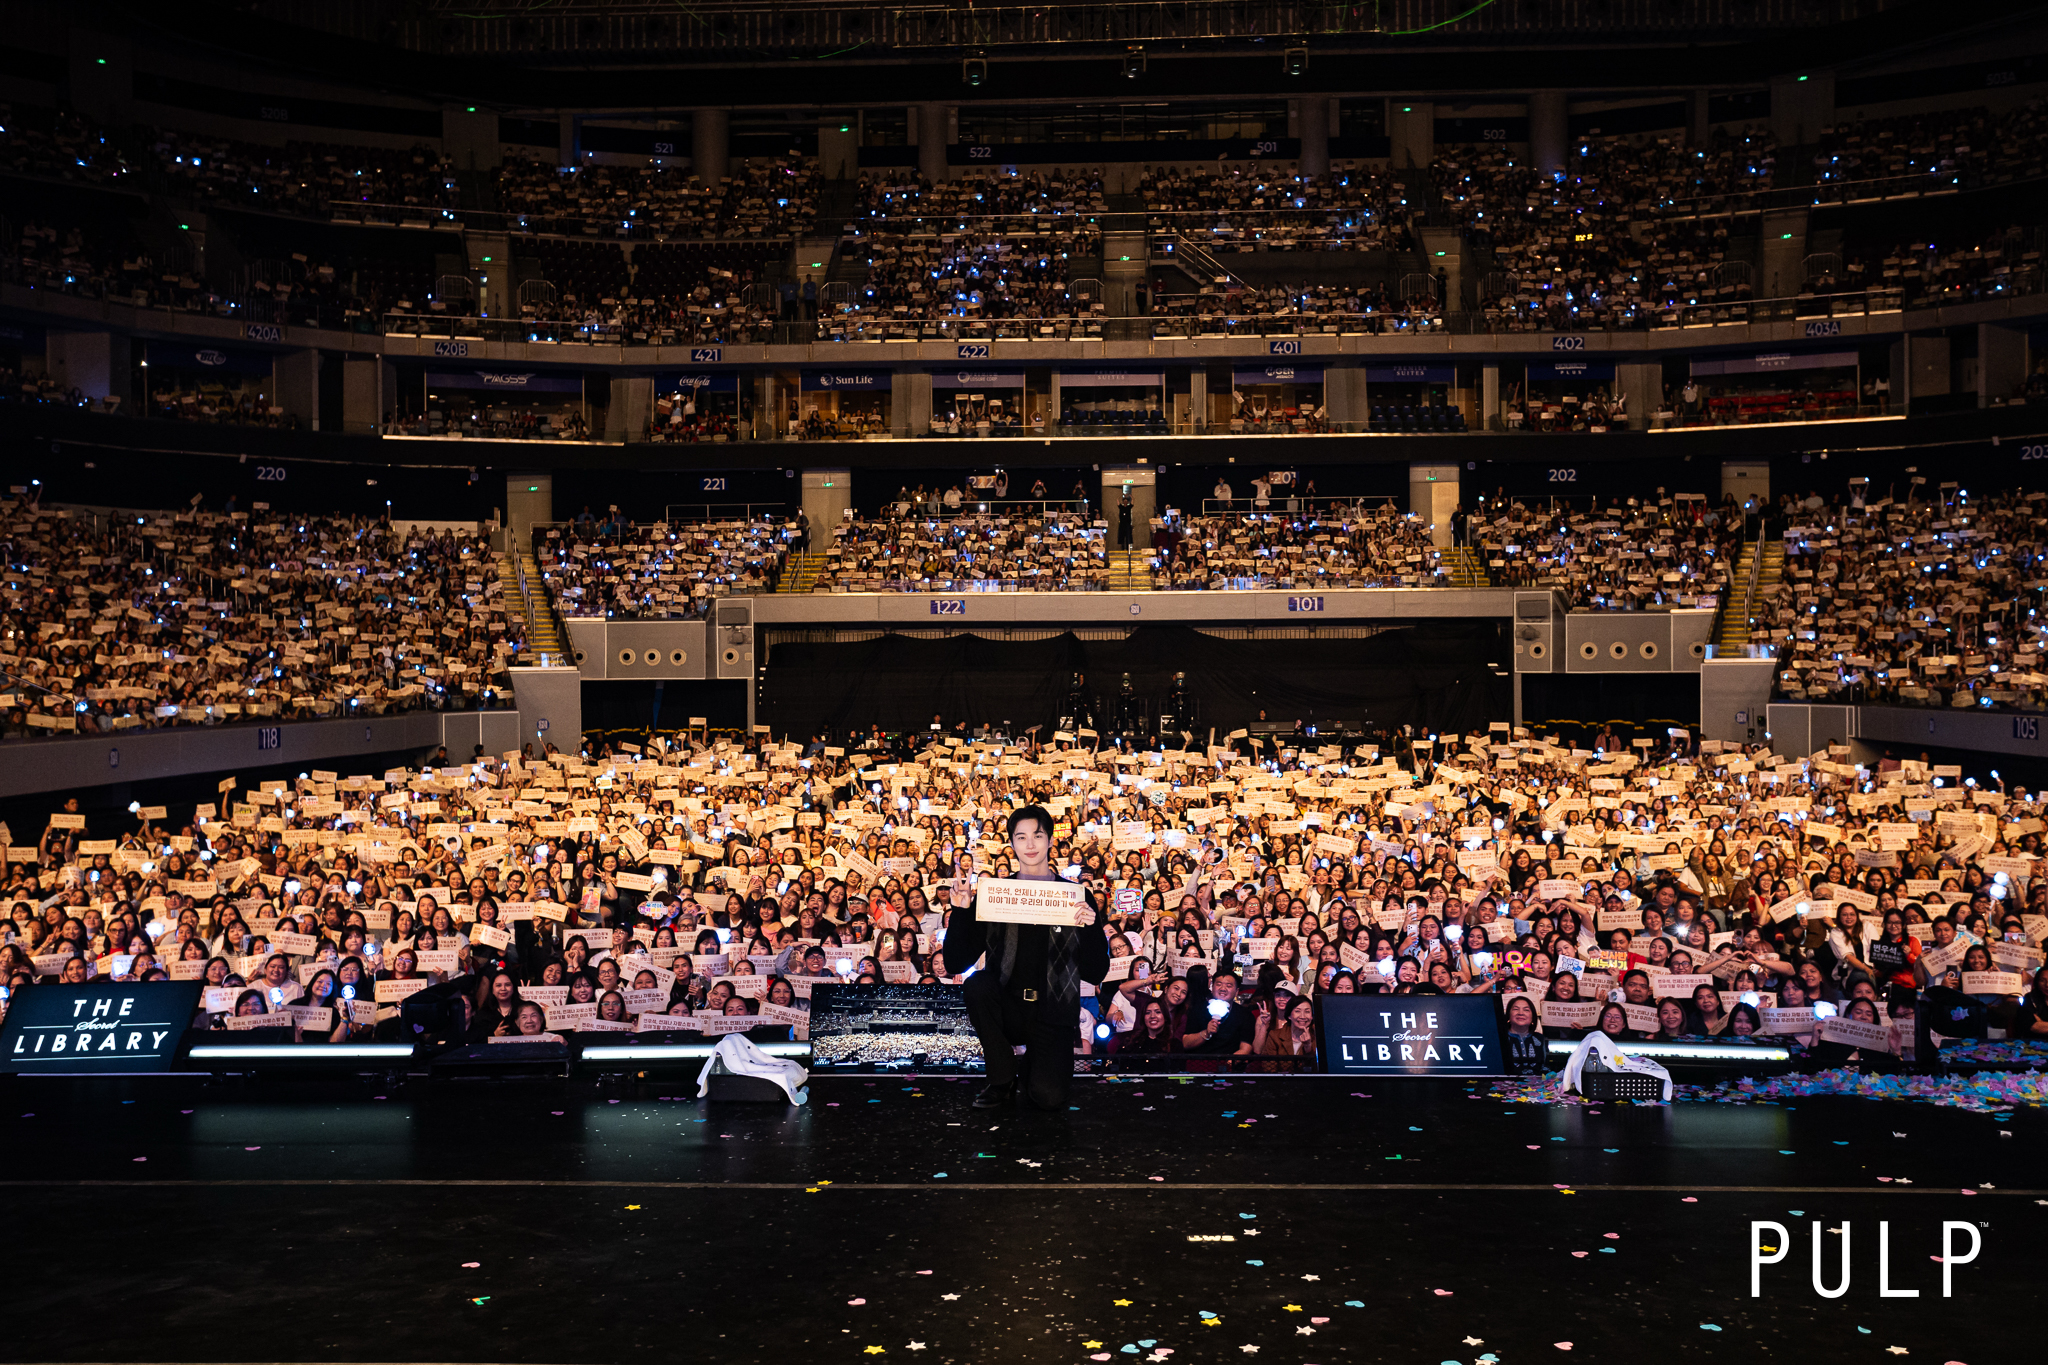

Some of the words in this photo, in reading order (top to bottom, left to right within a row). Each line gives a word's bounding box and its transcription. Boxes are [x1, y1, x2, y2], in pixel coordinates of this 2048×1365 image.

[1483, 129, 1507, 141] 502
[654, 142, 674, 154] 521
[969, 146, 992, 158] 522
[1256, 141, 1277, 153] 501
[247, 325, 279, 341] 420A
[1806, 321, 1840, 336] 403A
[435, 341, 467, 356] 420B
[1272, 341, 1299, 354] 401
[1553, 336, 1584, 350] 402
[694, 349, 719, 362] 421
[960, 345, 988, 358] 422
[483, 373, 528, 384] PAGSS
[836, 375, 854, 384] Sun
[856, 374, 873, 384] Life
[256, 466, 286, 481] 220
[1549, 469, 1577, 482] 202
[703, 478, 726, 490] 221
[936, 600, 962, 614] 122
[1294, 597, 1319, 611] 101
[2016, 718, 2037, 739] 105
[261, 728, 278, 749] 118
[988, 896, 1018, 905] 이야기할
[1020, 898, 1043, 906] 우리의
[1045, 899, 1067, 907] 이야기
[1873, 944, 1898, 955] 변우석
[73, 998, 134, 1017] THE
[74, 1018, 120, 1032] Secret
[1380, 1012, 1438, 1028] THE
[14, 1031, 168, 1053] LIBRARY
[1392, 1030, 1432, 1042] Secret
[1342, 1044, 1484, 1060] LIBRARY
